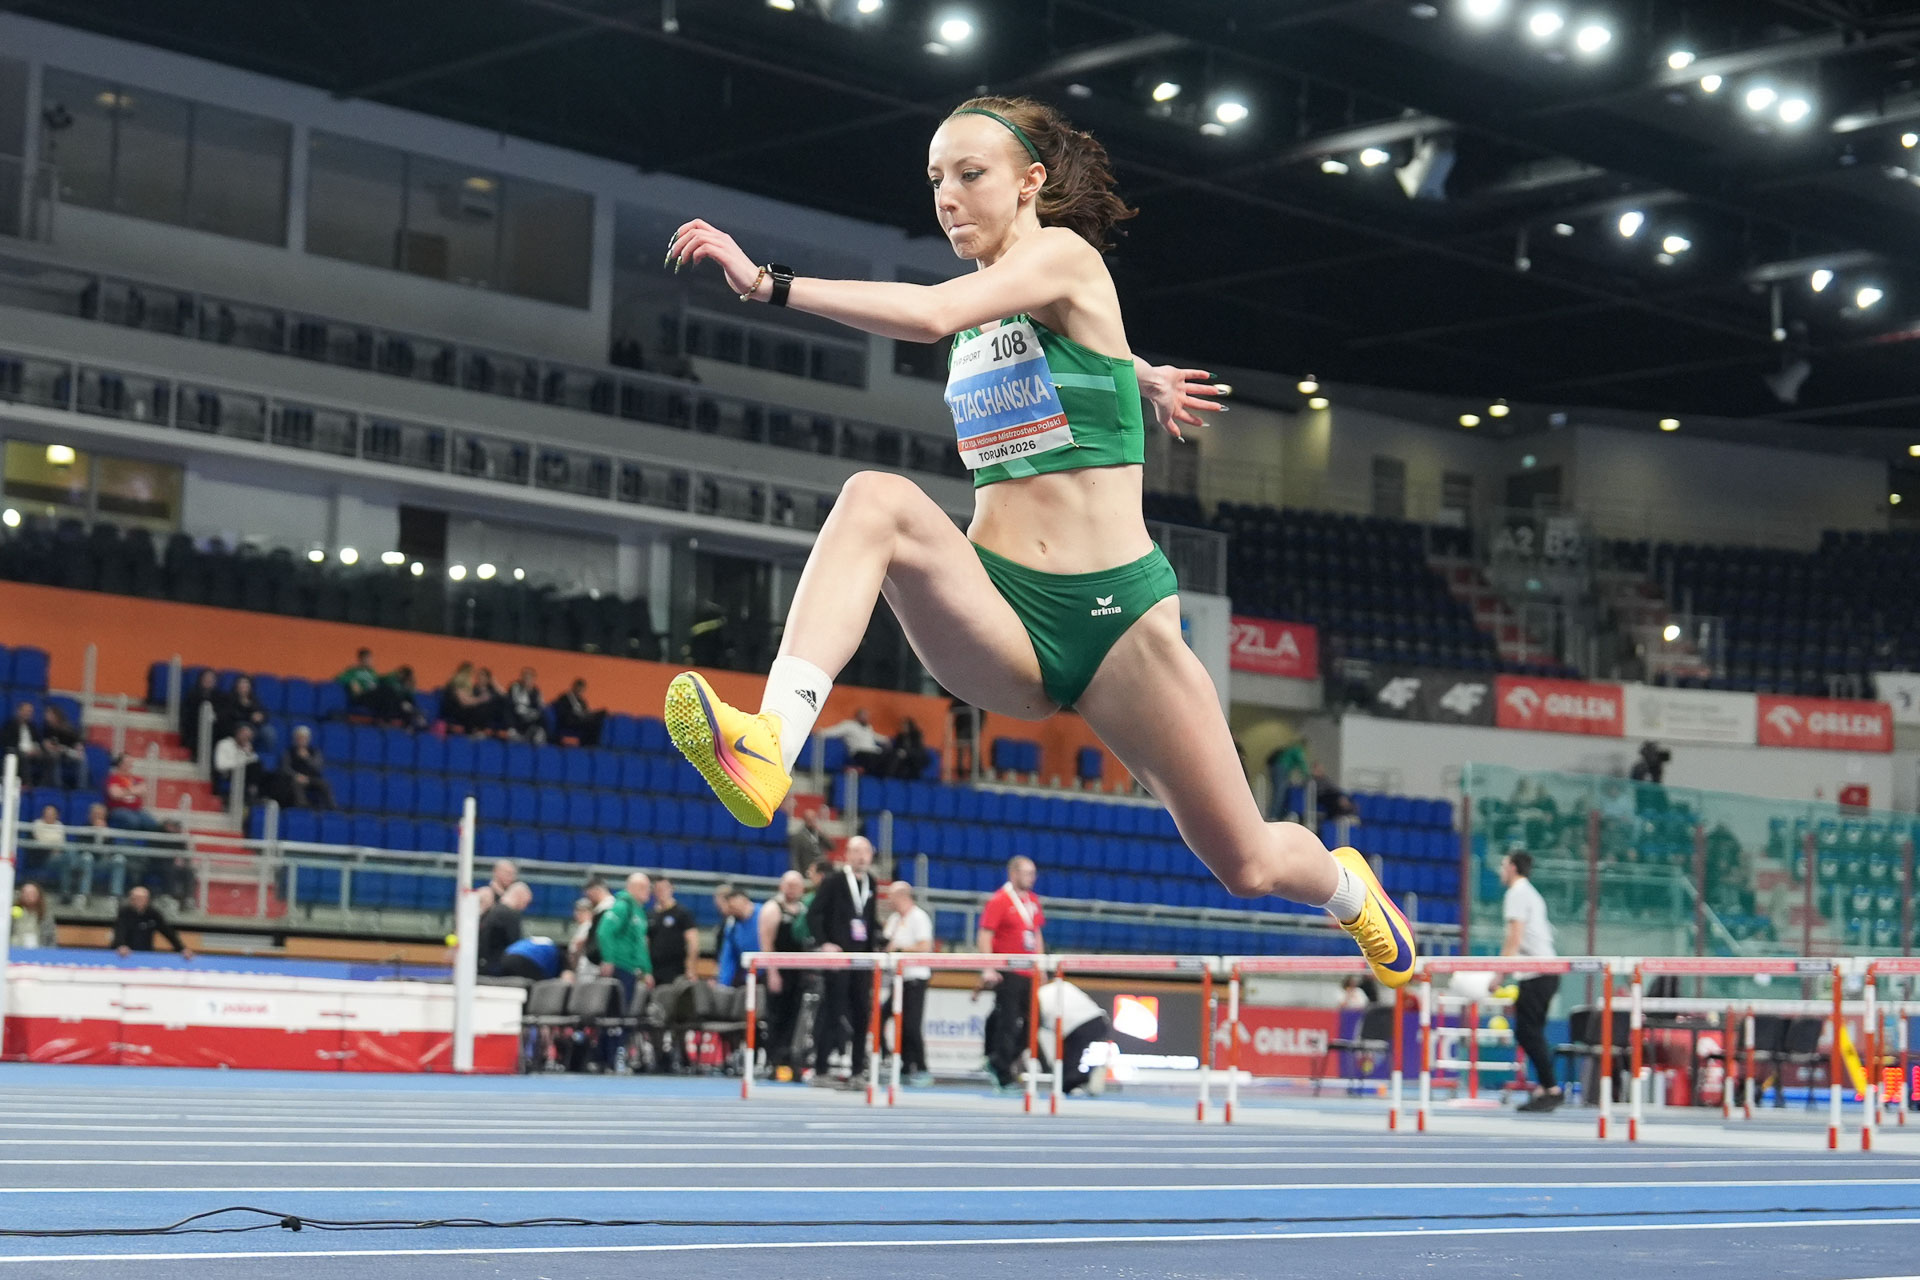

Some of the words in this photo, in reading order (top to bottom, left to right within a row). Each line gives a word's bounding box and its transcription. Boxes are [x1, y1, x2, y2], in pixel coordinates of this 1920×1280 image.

[991, 330, 1027, 361] 108
[998, 426, 1037, 440] Mistrzostwa
[1038, 417, 1061, 431] Polski
[978, 444, 1008, 462] TORUŃ
[1009, 440, 1037, 455] 2026
[1091, 606, 1122, 616] erima
[795, 690, 817, 712] adidas
[1544, 693, 1616, 721] ORLEN
[1807, 710, 1882, 737] ORLEN
